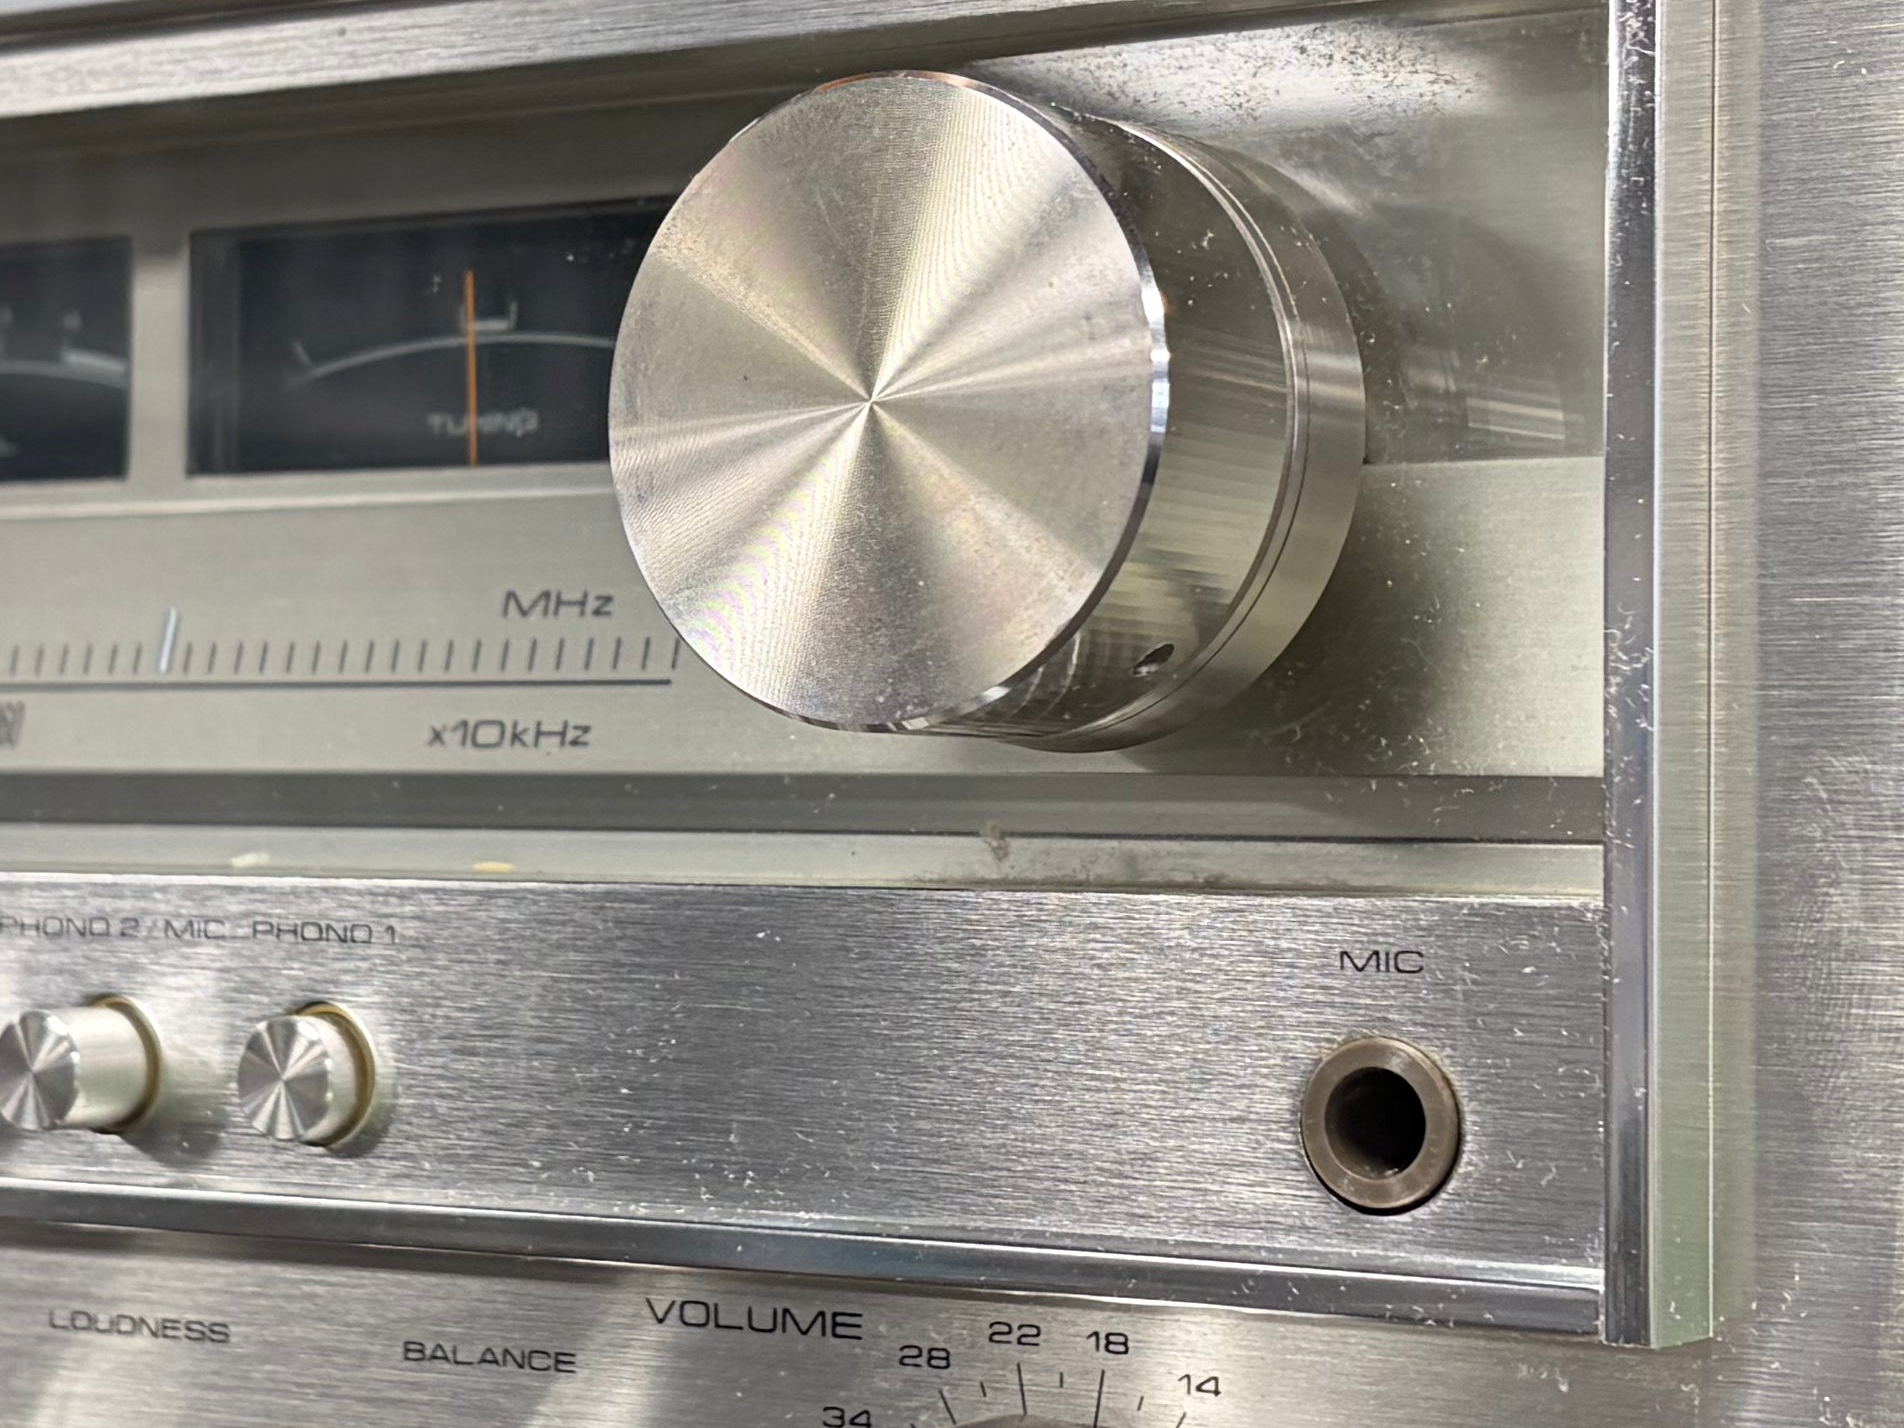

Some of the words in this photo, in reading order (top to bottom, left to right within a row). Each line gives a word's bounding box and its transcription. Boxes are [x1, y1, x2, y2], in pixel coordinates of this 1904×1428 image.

[502, 590, 614, 617] MHz
[427, 719, 593, 750] x10kHz
[251, 919, 373, 944] PHONO
[385, 924, 397, 945] 1
[1338, 949, 1425, 974] MIC
[48, 1309, 231, 1344] LOUDNESS
[645, 1297, 864, 1341] VOLUME
[988, 1321, 1042, 1347] 22
[1086, 1331, 1130, 1355] 18
[402, 1340, 577, 1373] BALANCE
[898, 1344, 951, 1370] 28
[1177, 1374, 1222, 1397] 14
